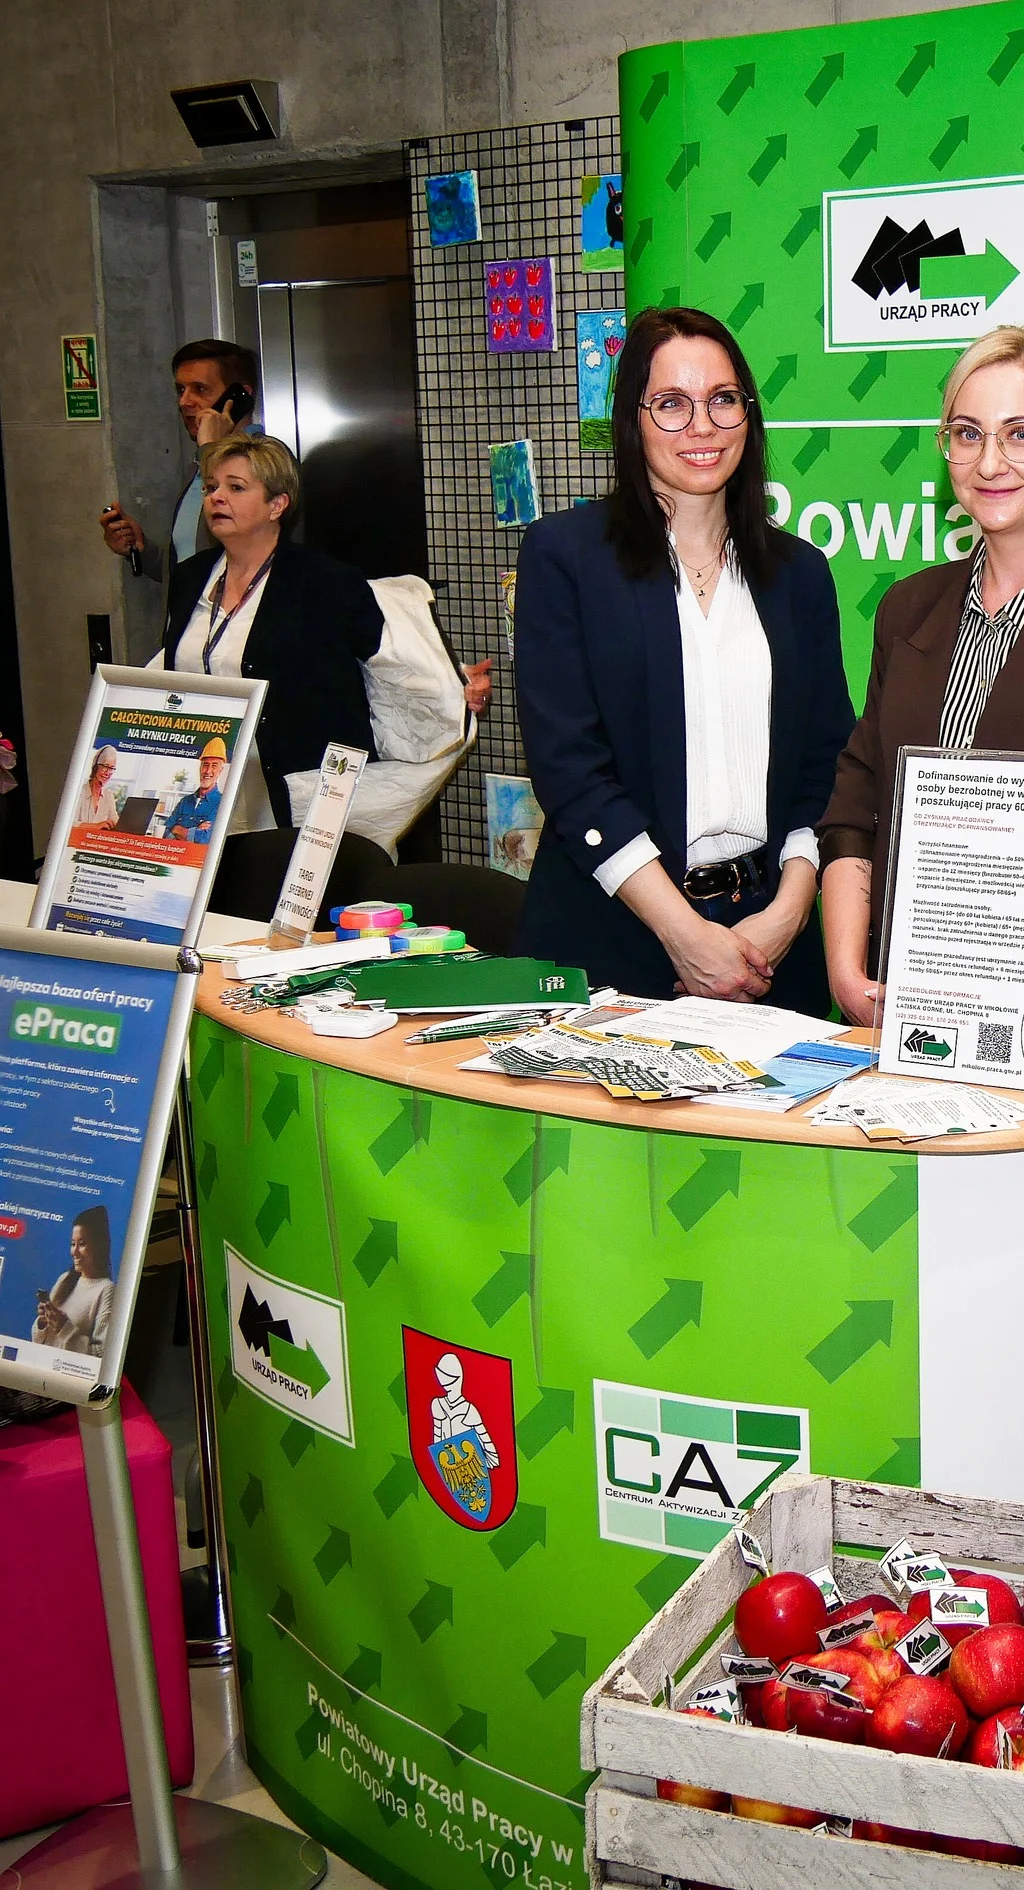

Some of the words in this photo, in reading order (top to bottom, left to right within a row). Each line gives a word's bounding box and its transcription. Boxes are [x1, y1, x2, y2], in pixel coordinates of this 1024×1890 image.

[240, 251, 254, 260] 24h
[880, 304, 927, 322] URZĄD
[931, 302, 980, 318] PRACY
[110, 710, 172, 728] CAŁOŻYCIOWA
[173, 717, 231, 734] AKTYWNOŚĆ
[127, 728, 140, 738] NA
[140, 730, 168, 742] RYNKU
[169, 732, 196, 745] PRACY
[918, 770, 994, 784] Dofinansowanie
[996, 775, 1008, 784] do
[916, 784, 946, 795] osoby
[948, 784, 1005, 800] bezrobotnej
[1006, 790, 1016, 798] w
[915, 795, 918, 804] i
[920, 797, 984, 811] poszukującej
[985, 801, 1012, 812] pracy
[51, 982, 81, 998] baza
[82, 988, 116, 1004] ofert
[116, 994, 154, 1012] pracy
[956, 1002, 976, 1010] PRACY
[15, 1006, 116, 1048] ePraca
[66, 1066, 94, 1076] zawiera
[94, 1070, 130, 1084] informacje
[962, 1062, 1022, 1076] mikolow.praca.gov.pl
[19, 1206, 49, 1220] marzysz
[50, 1213, 64, 1222] na:
[252, 1357, 277, 1384] URZĄD
[279, 1374, 309, 1400] PRACY
[605, 1426, 799, 1510] CAZ
[307, 1681, 396, 1778] Powiatowy
[402, 1756, 465, 1816] Urząd
[472, 1797, 544, 1858] Pracy
[550, 1840, 574, 1866] w
[317, 1732, 334, 1762] ul.
[340, 1746, 408, 1819] Chopina
[414, 1802, 433, 1838] 8,
[439, 1820, 516, 1878] 43-170
